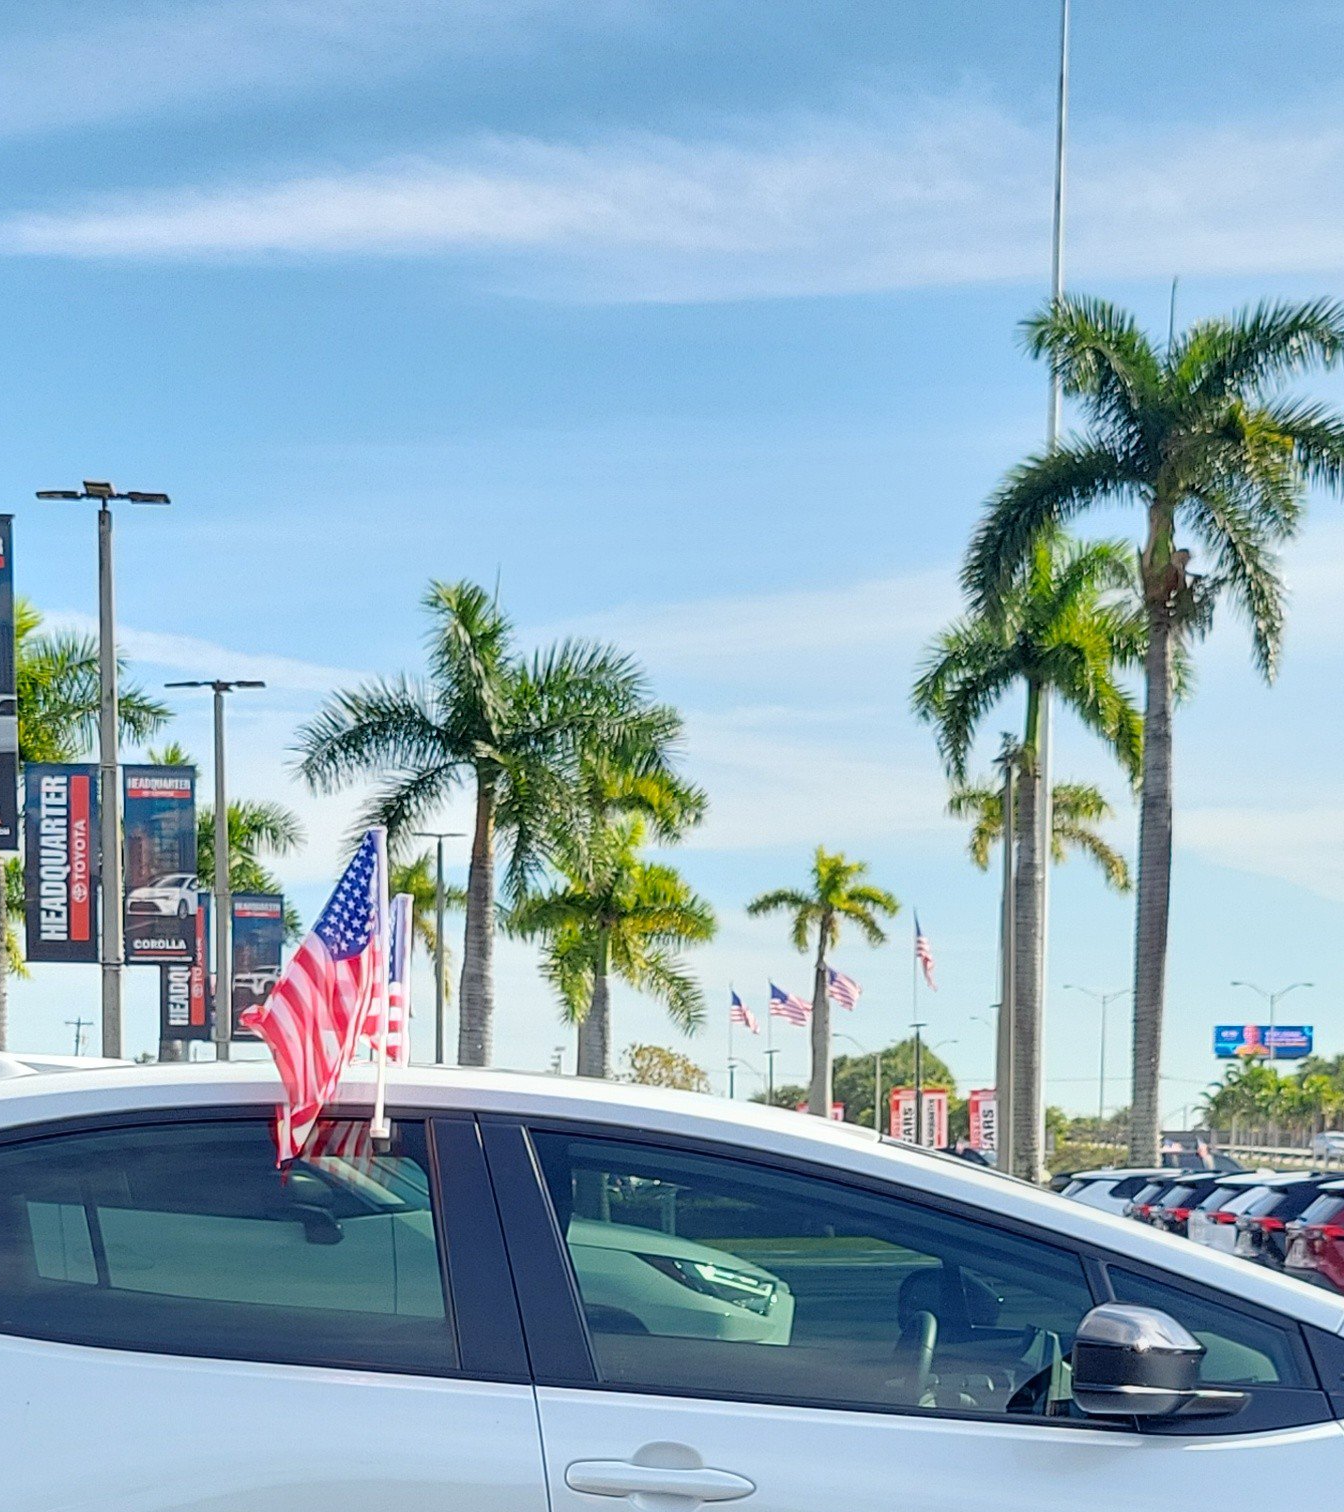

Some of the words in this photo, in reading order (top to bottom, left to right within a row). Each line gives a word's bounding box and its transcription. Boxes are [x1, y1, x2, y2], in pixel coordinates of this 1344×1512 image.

[40, 775, 71, 941] HEADQUARTER
[74, 819, 87, 880] TOYOTA
[133, 938, 186, 950] COROLLA
